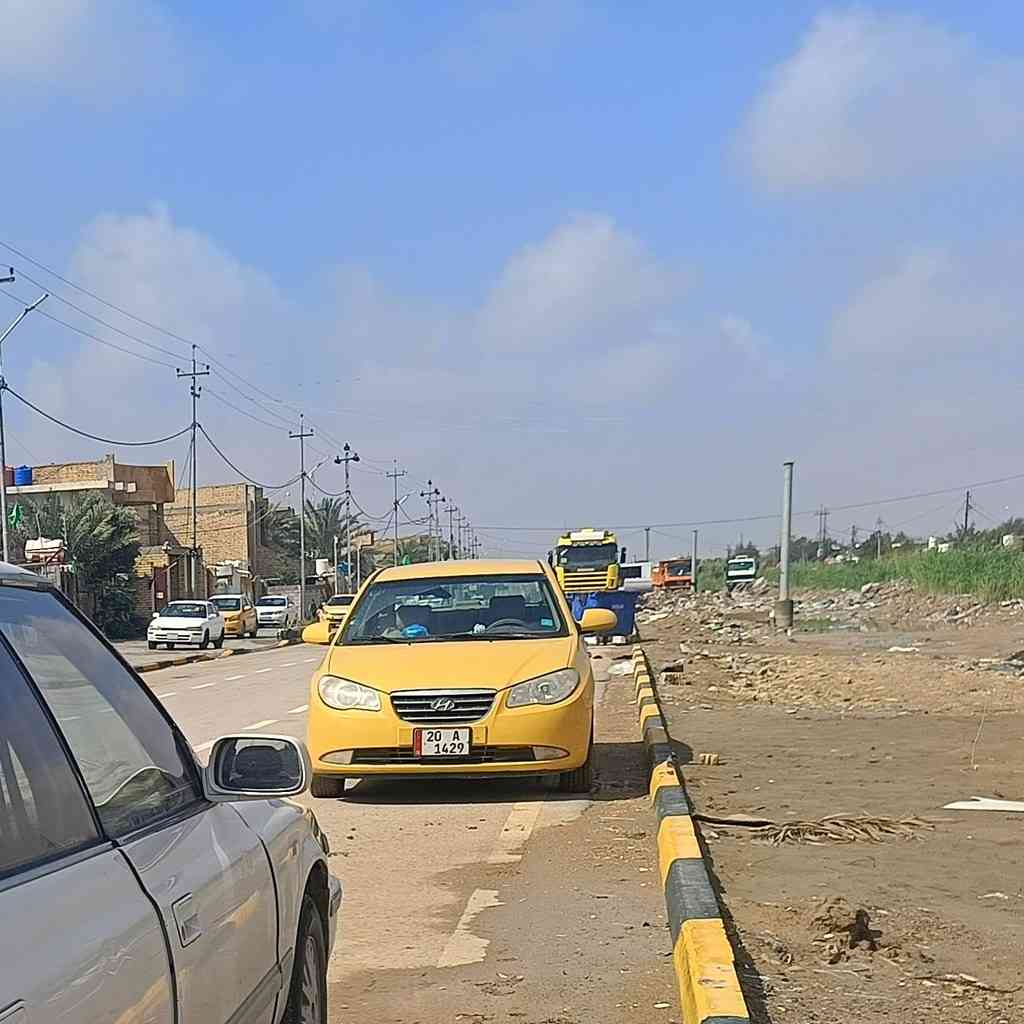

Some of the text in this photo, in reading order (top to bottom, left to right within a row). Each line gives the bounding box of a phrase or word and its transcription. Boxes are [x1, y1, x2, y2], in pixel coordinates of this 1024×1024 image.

[426, 730, 460, 742] 20 A
[434, 743, 464, 754] 1429
